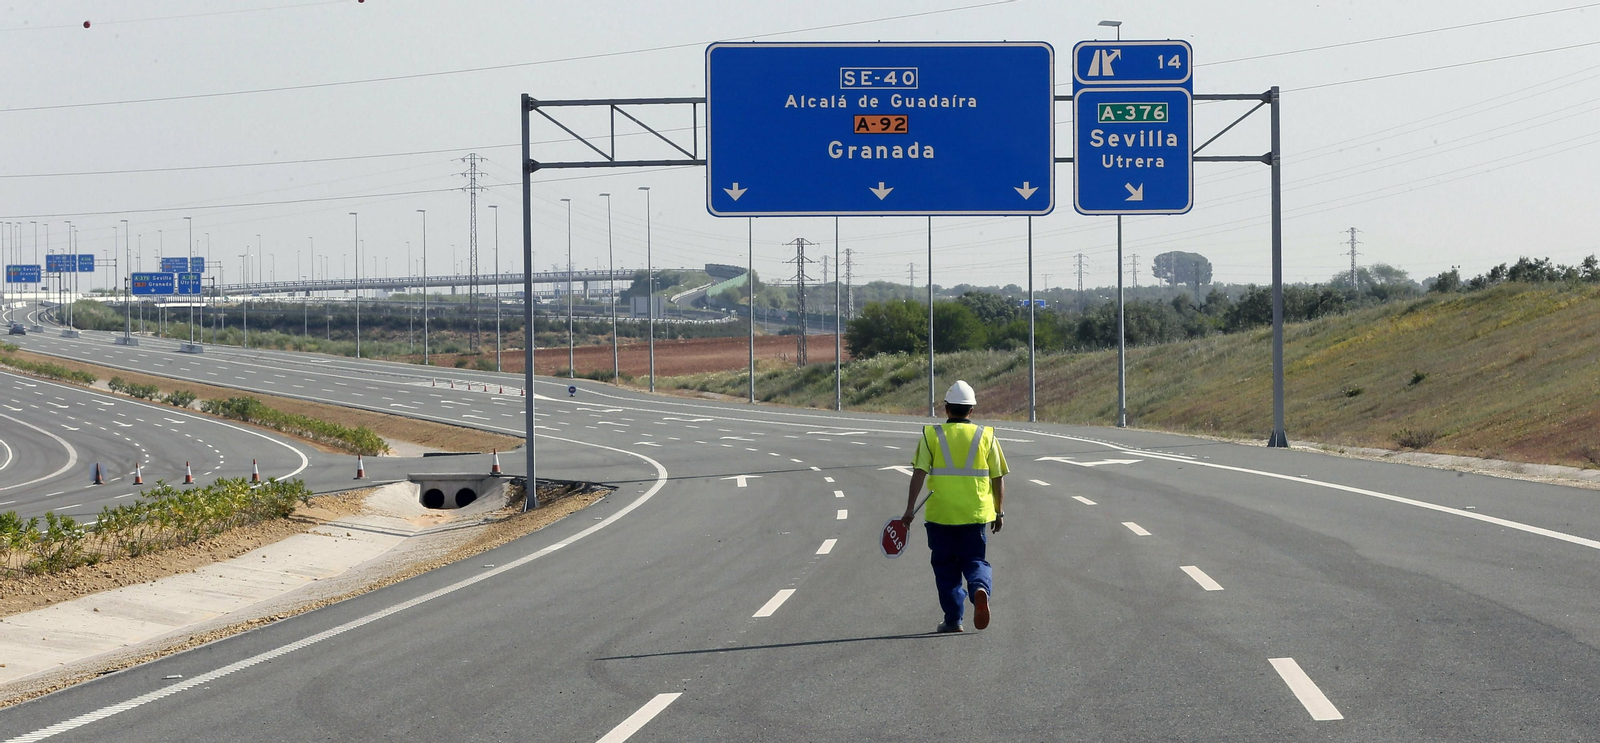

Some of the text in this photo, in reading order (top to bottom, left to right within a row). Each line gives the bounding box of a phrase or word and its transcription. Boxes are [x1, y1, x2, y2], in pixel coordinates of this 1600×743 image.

[1157, 54, 1182, 69] 14
[843, 70, 916, 86] SE-40
[784, 93, 978, 109] Alcalá de Guadaíra
[1100, 105, 1166, 121] A-376
[856, 117, 907, 132] A-92
[1089, 129, 1178, 148] Sevilla
[828, 140, 935, 160] Granada
[1102, 154, 1165, 168] Utrera
[886, 525, 903, 550] STOP
